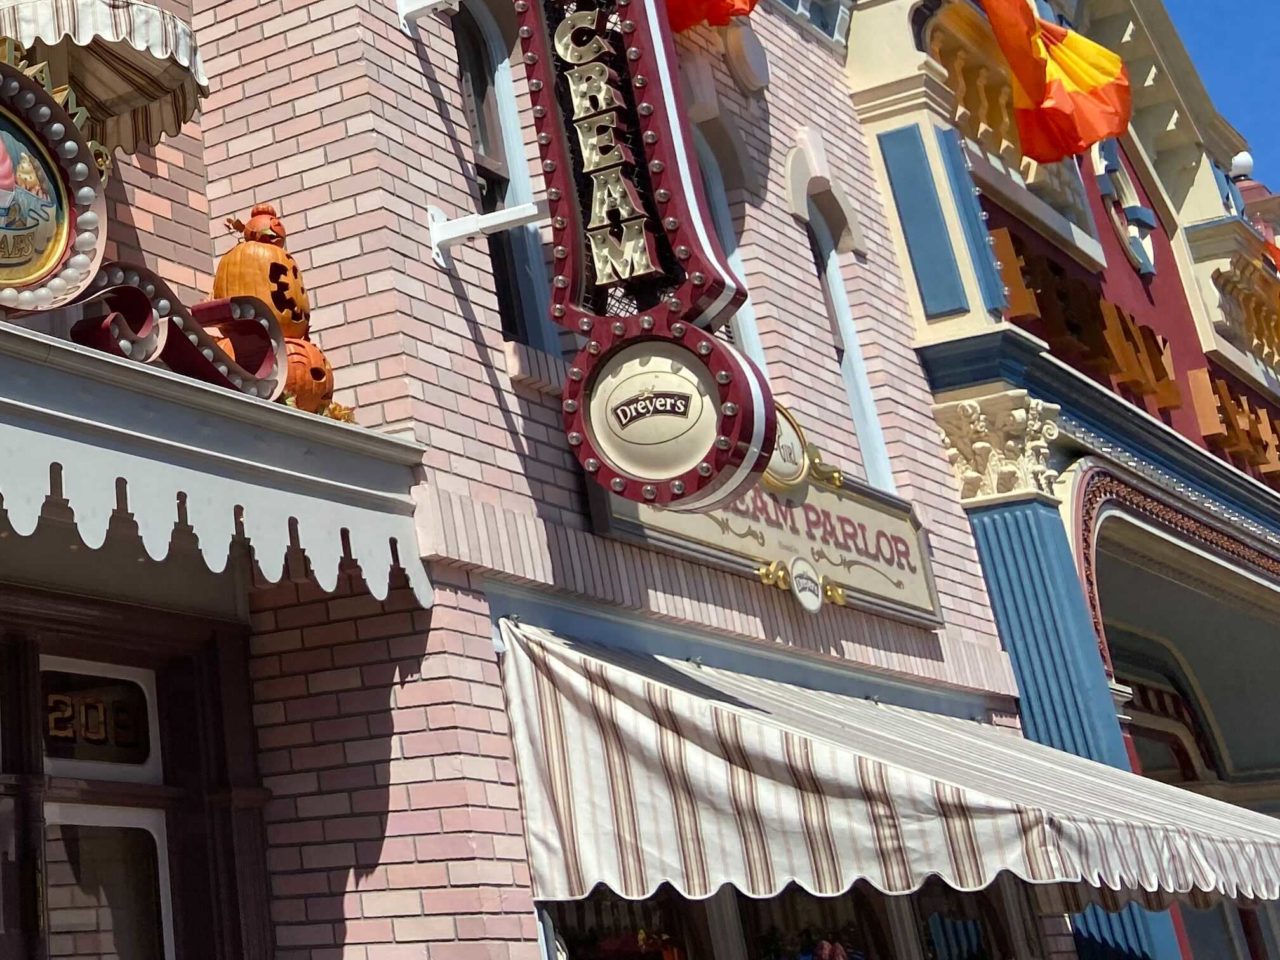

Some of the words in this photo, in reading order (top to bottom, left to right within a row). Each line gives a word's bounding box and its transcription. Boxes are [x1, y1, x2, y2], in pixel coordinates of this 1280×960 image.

[554, 10, 662, 286] CREAM
[615, 396, 686, 425] Dreyer's
[803, 503, 917, 574] PARLOR
